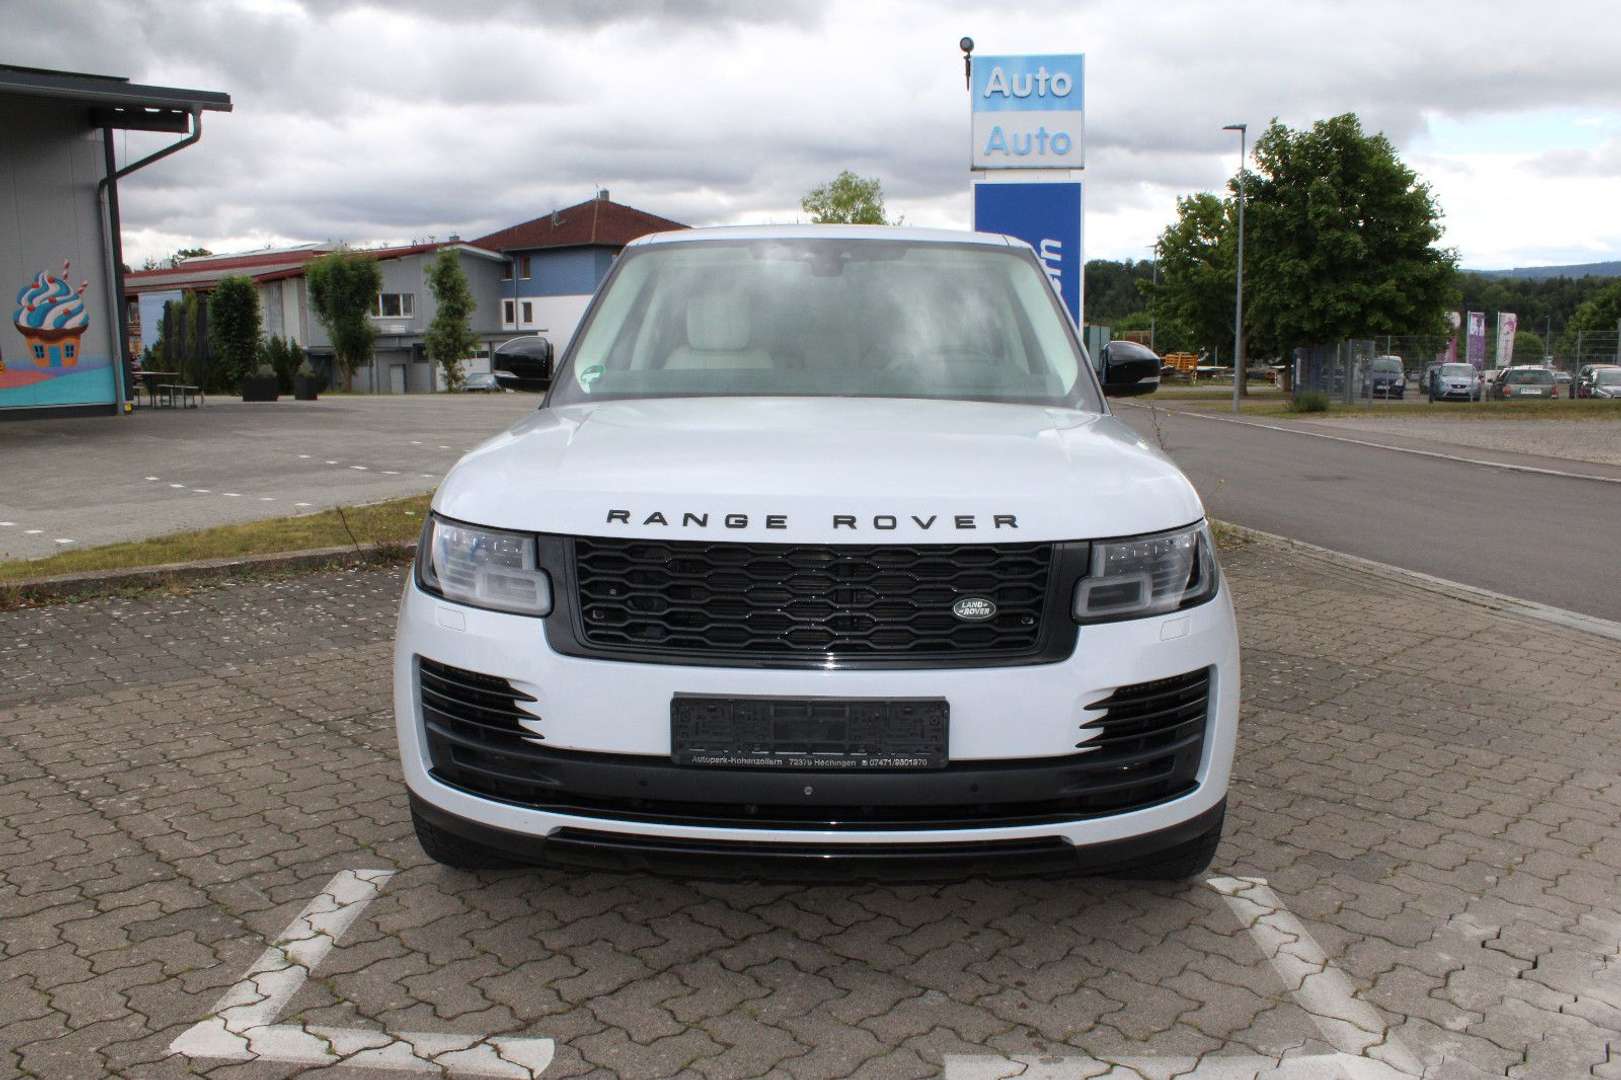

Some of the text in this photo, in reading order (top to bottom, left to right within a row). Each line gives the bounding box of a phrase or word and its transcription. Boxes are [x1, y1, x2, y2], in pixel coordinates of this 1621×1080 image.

[984, 66, 1072, 98] Auto
[984, 125, 1072, 156] Auto
[607, 509, 1018, 530] RANGE ROVER
[963, 607, 990, 615] ROVER
